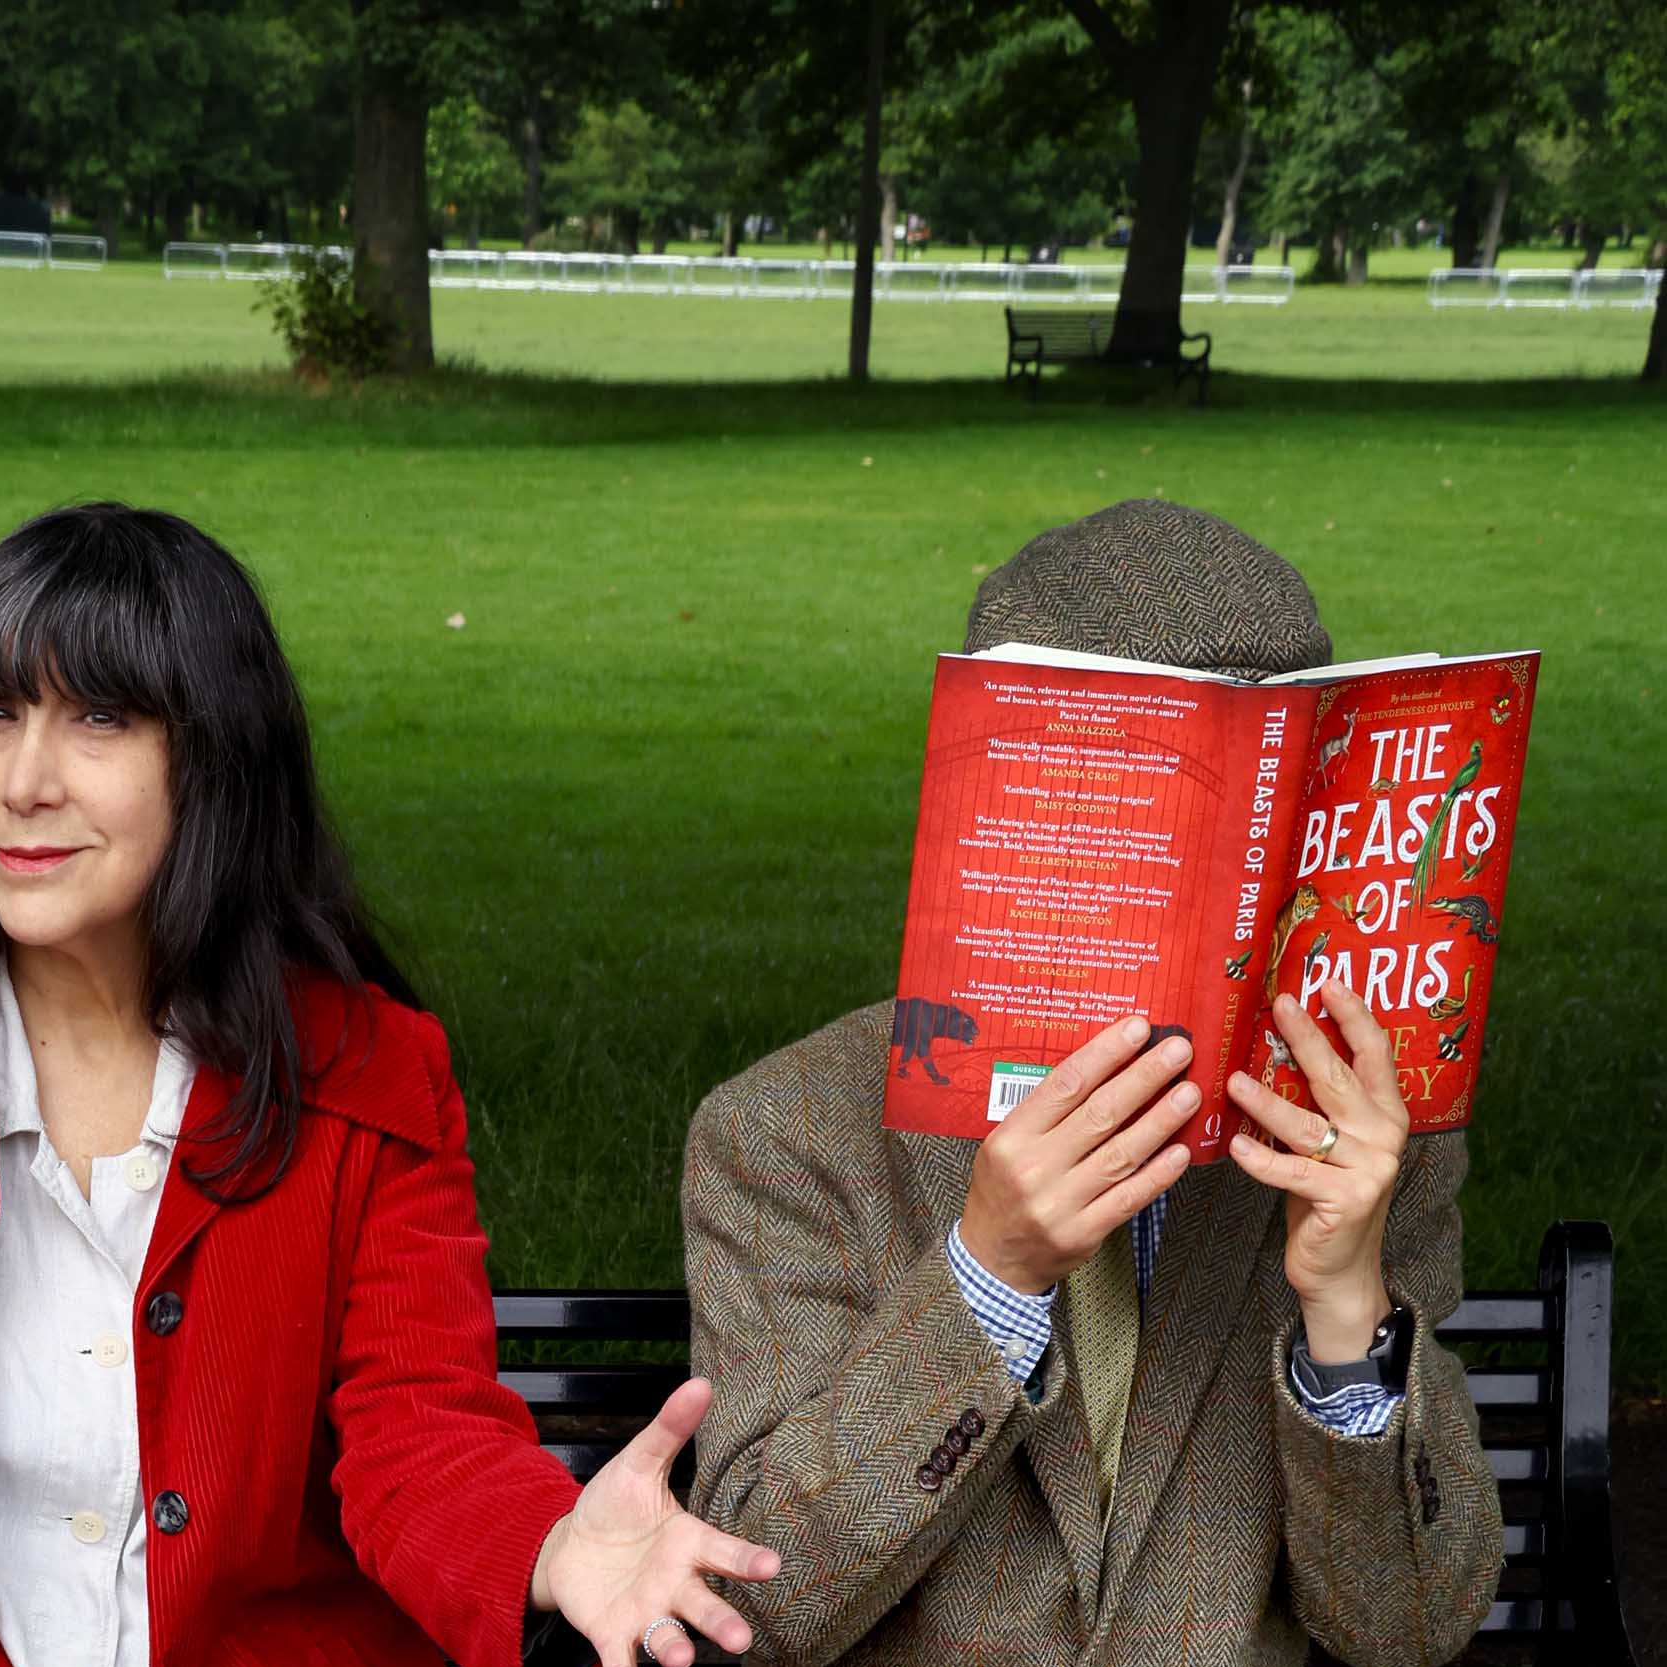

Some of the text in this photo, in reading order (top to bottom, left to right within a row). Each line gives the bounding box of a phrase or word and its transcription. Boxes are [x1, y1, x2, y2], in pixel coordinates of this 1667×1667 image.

[1045, 723, 1127, 737] ANNA MAZZOLA
[1370, 724, 1452, 785] THE
[1235, 708, 1287, 941] THE BEASTS OF PARIS
[1296, 786, 1501, 879] BEASTS
[1356, 879, 1414, 934] OF
[1300, 941, 1454, 1019] PARIS
